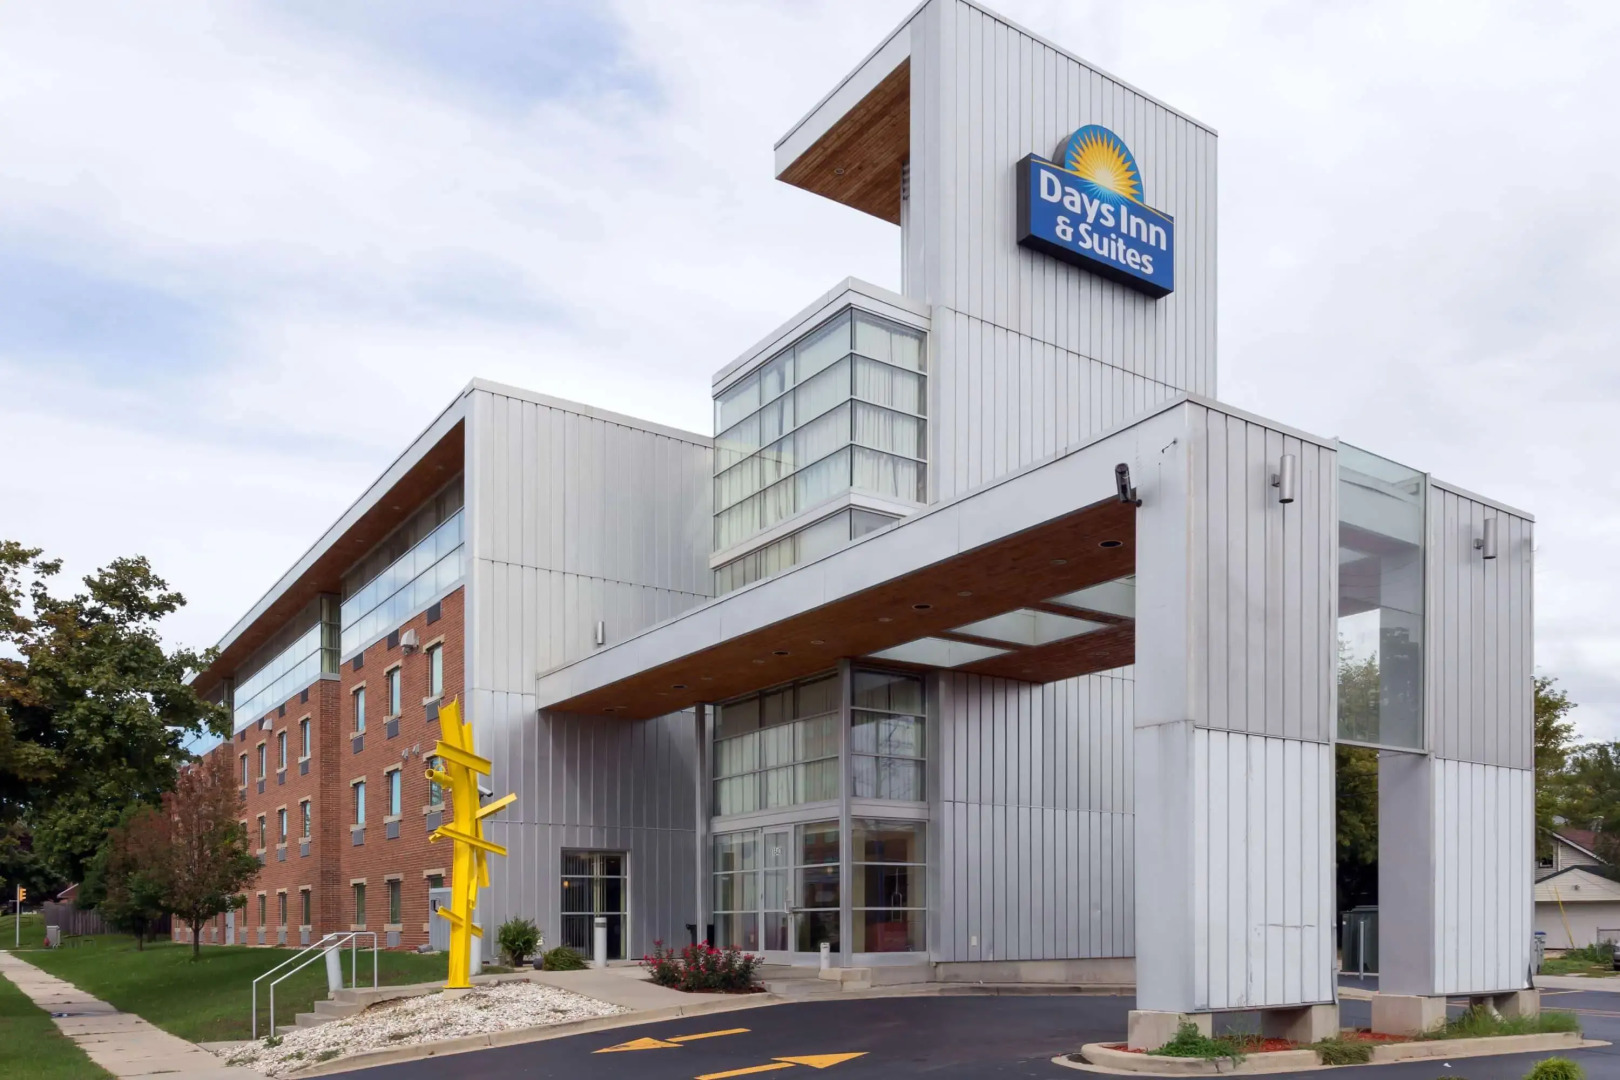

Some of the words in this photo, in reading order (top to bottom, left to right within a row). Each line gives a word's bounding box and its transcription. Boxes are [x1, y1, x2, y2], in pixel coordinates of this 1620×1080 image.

[1040, 168, 1115, 227] Days
[1120, 204, 1167, 251] Inn
[1055, 215, 1074, 242] &
[1078, 223, 1154, 275] Suites
